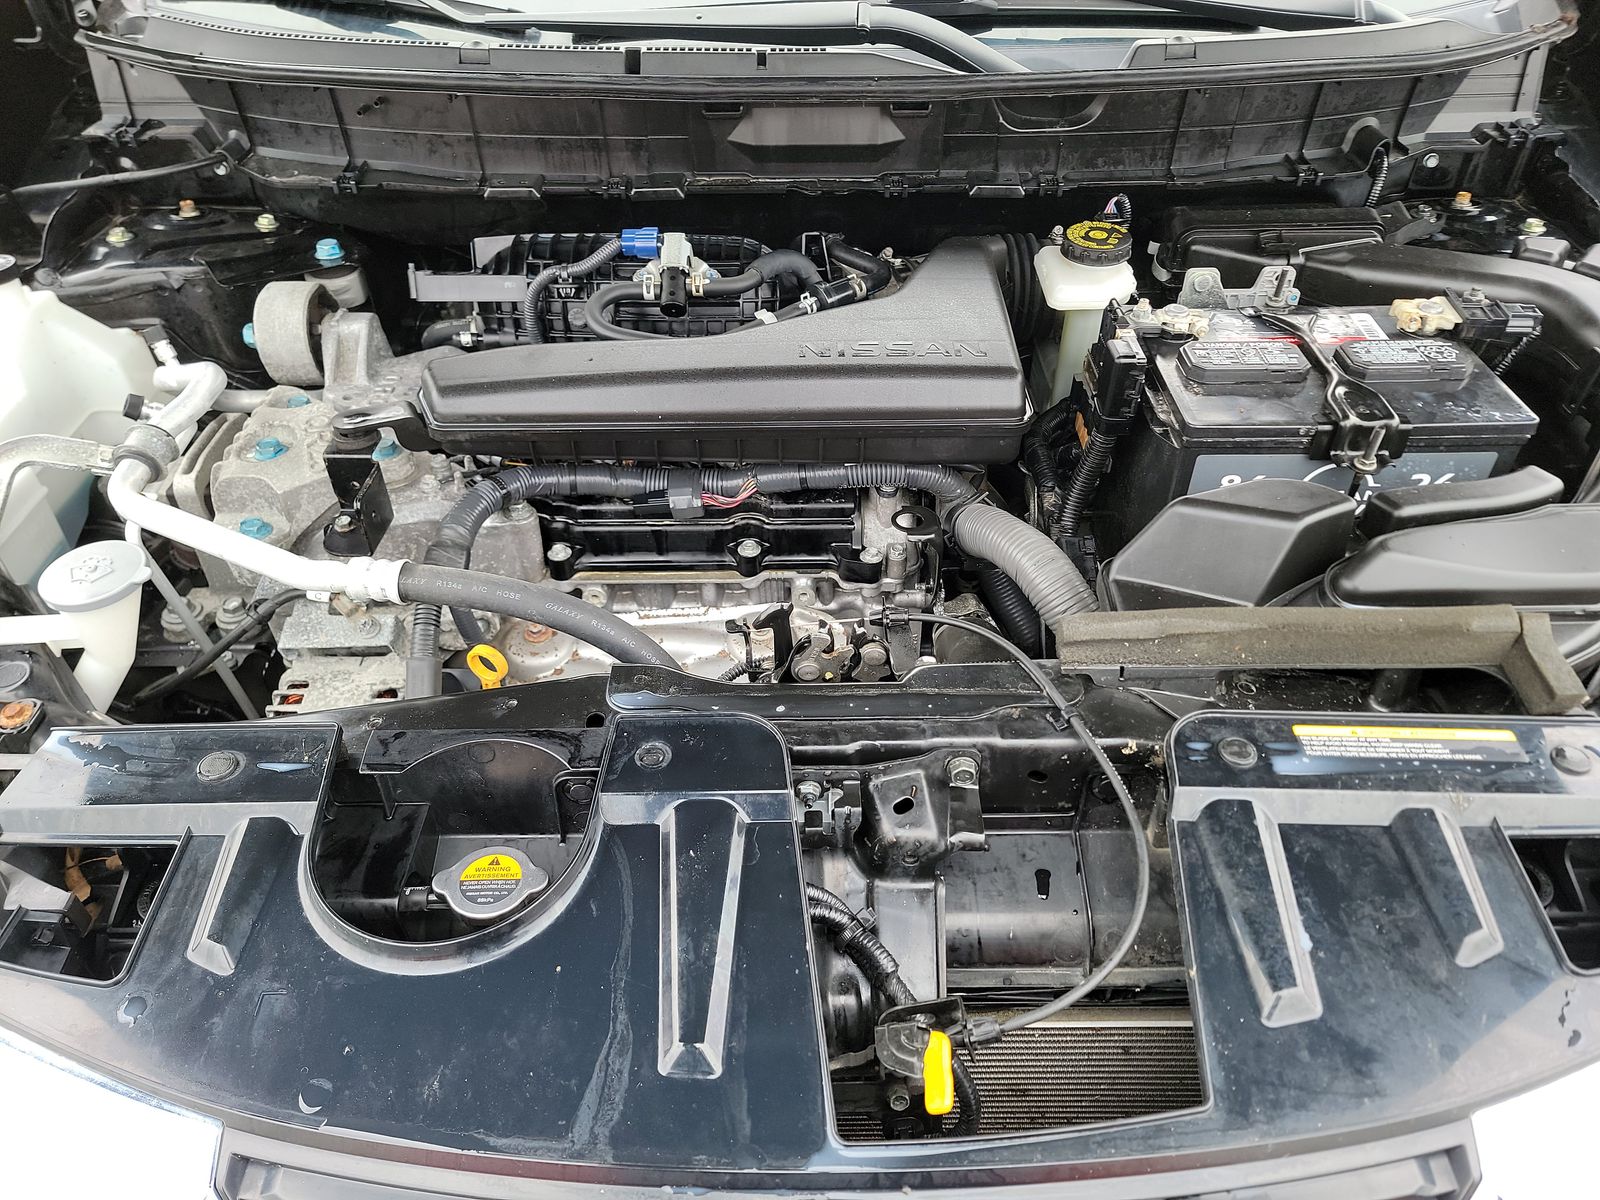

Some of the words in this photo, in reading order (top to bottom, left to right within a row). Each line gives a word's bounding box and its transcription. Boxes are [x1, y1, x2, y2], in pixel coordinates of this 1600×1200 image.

[799, 341, 988, 358] NISSAN
[400, 577, 427, 585] LAXY
[471, 585, 488, 593] A/C
[496, 590, 522, 601] HOSE
[545, 602, 585, 620] GALAXY
[621, 636, 637, 648] A/C
